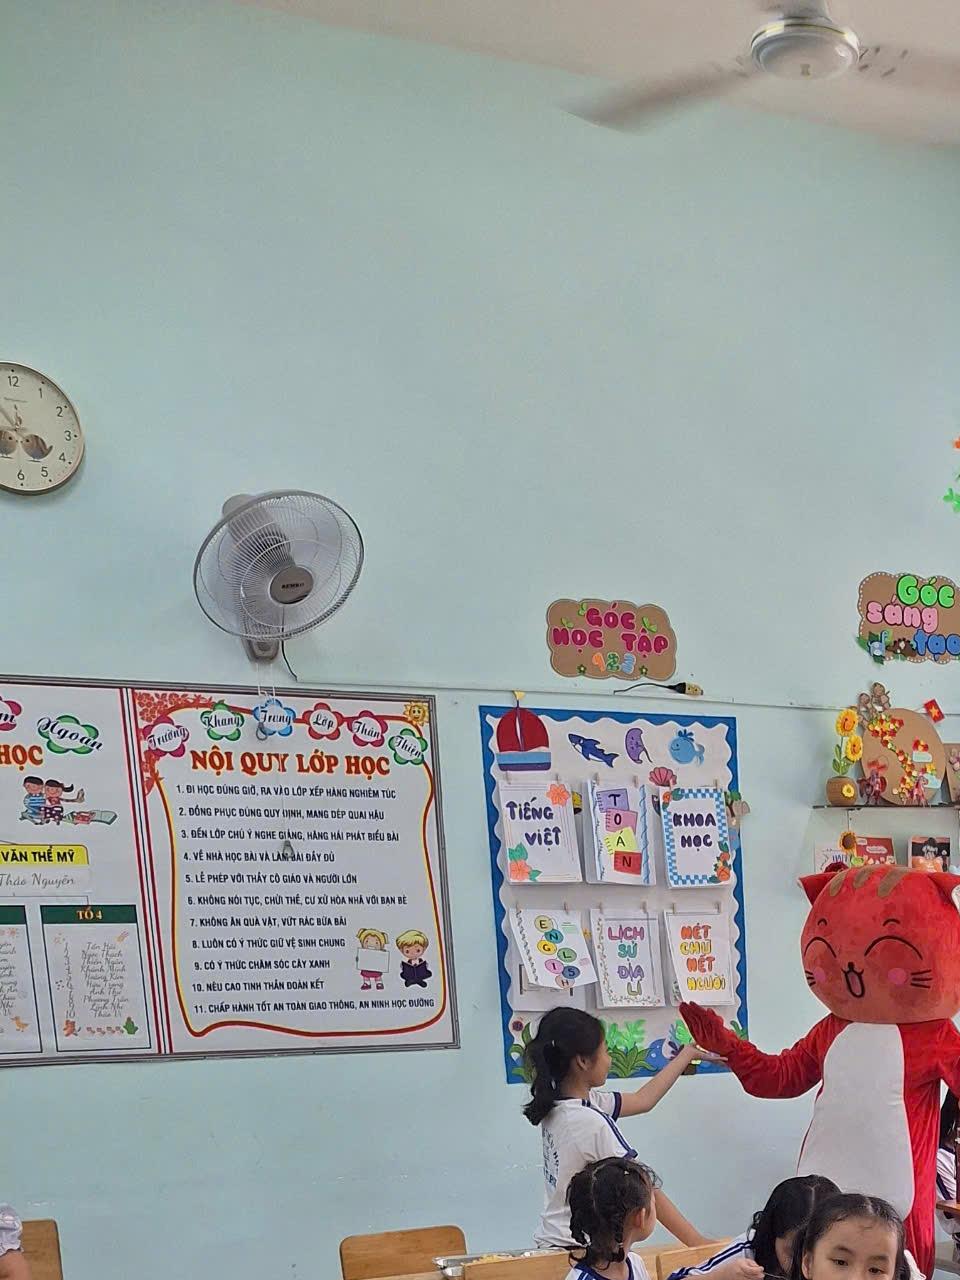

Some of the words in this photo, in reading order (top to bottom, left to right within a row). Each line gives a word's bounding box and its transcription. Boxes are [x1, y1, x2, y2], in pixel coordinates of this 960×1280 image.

[7, 375, 20, 388] 12
[55, 406, 63, 417] 2
[64, 430, 72, 441] 3
[58, 452, 66, 462] 4
[17, 469, 25, 481] 6
[41, 466, 49, 477] 5
[896, 574, 955, 608] Góc
[585, 602, 636, 630] GÓC
[866, 593, 938, 633] sáng
[552, 627, 604, 653] HỌC
[621, 627, 669, 658] TẬP
[37, 716, 103, 751] Ngoan
[0, 745, 44, 771] HỌC
[190, 745, 235, 776] NỘI
[240, 751, 289, 776] QUY
[296, 748, 339, 774] LỚP
[345, 755, 390, 780] HỌC
[177, 785, 184, 793] 1.
[261, 787, 272, 795] RA
[179, 807, 186, 816] 2.
[264, 809, 280, 817] QUY
[306, 810, 329, 818] MANG
[348, 811, 367, 819] QUAI
[672, 812, 717, 827] KHOA
[181, 829, 188, 838] 3.
[255, 831, 276, 839] NGHE
[680, 834, 713, 852] HỌC
[1, 848, 28, 862] VĂN
[31, 845, 53, 862] THỂ
[57, 847, 75, 862] MỸ
[184, 852, 191, 861] 4.
[185, 874, 193, 883] 5.
[187, 896, 195, 905] 6.
[190, 918, 197, 927] 7.
[192, 940, 199, 949] 8.
[298, 939, 316, 947] SINH
[319, 939, 345, 947] CHUNG
[194, 962, 202, 970] 9.
[309, 960, 330, 968] XANH
[192, 984, 204, 992] 10.
[225, 982, 240, 991] CAO
[243, 982, 261, 990] TINH
[194, 1005, 206, 1013] 11.
[274, 1002, 284, 1011] AN
[309, 1002, 327, 1010] GIAO
[359, 1001, 369, 1009] AN
[372, 1000, 389, 1008] NINH
